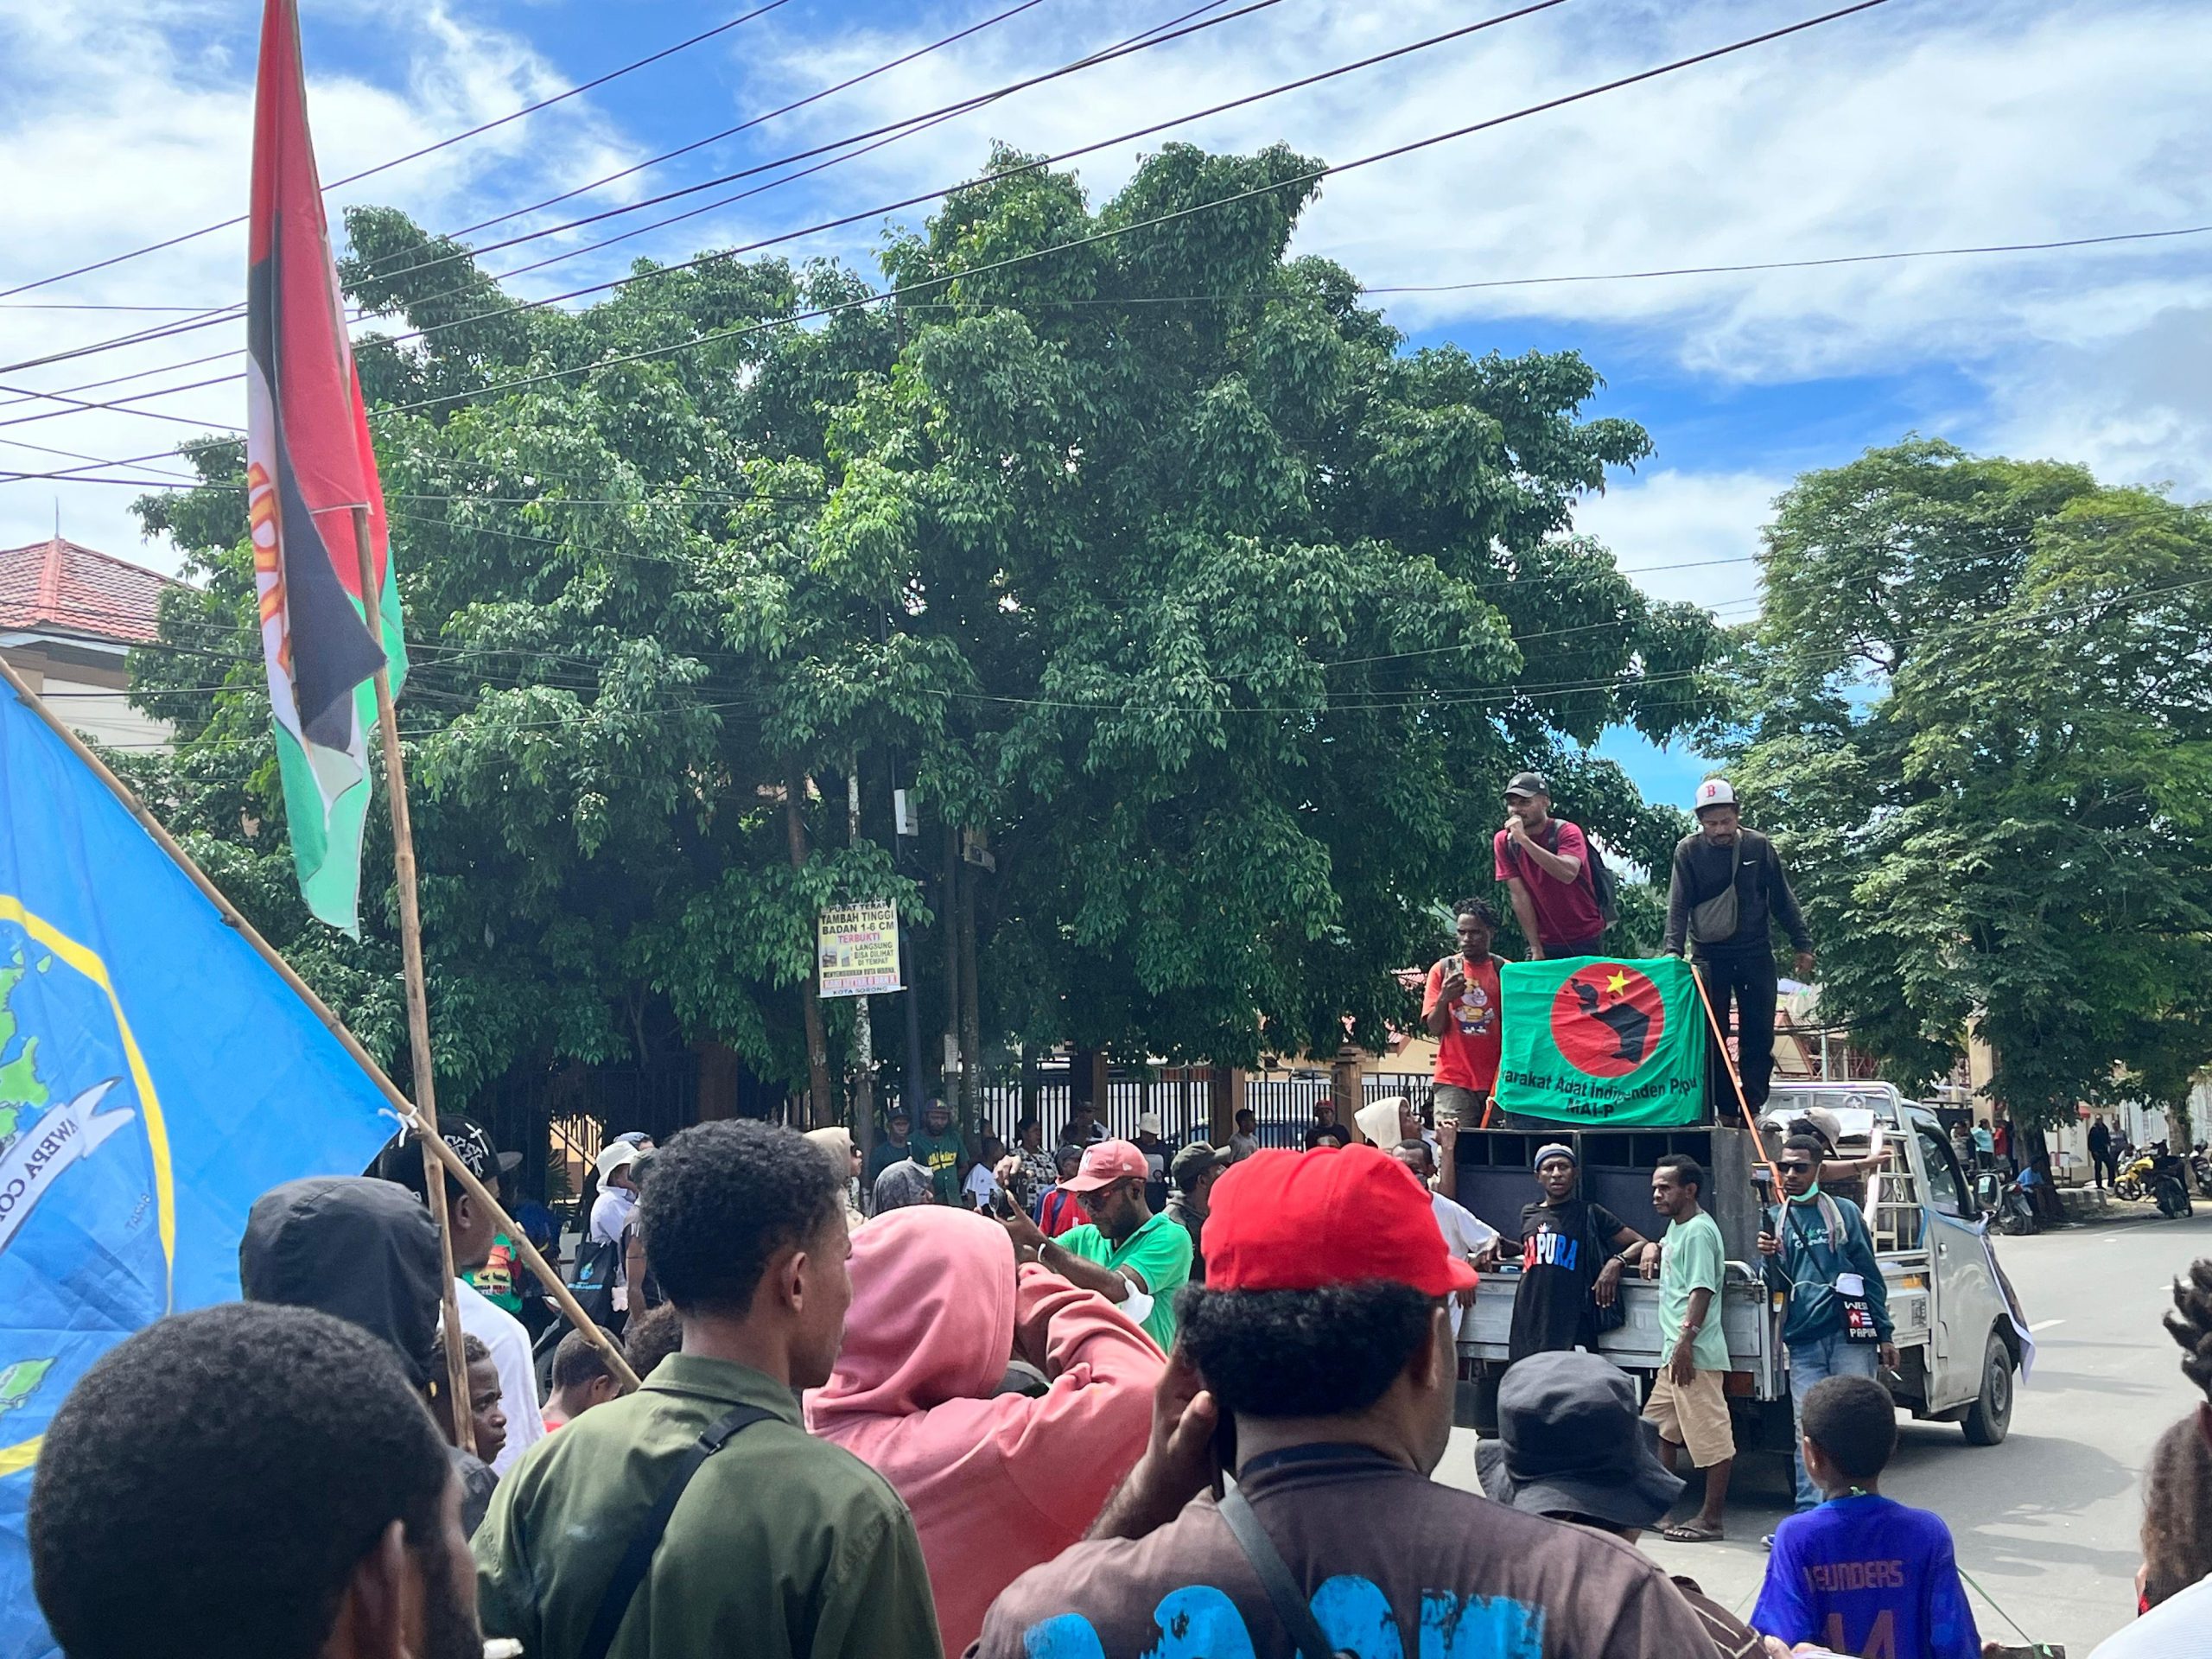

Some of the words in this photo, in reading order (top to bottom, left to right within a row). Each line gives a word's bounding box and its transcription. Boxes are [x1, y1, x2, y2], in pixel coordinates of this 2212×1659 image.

[1706, 785, 1715, 798] B
[822, 912, 859, 925] TAMBAH
[861, 910, 893, 921] TINGGI
[823, 924, 858, 935] BADAN
[879, 921, 894, 931] CM
[838, 933, 880, 944] TERBUKTI
[855, 942, 893, 951] LANGSUNG
[1503, 1070, 1552, 1090] arakat
[1555, 1076, 1587, 1096] Adat
[1566, 1098, 1614, 1117] MAI-P
